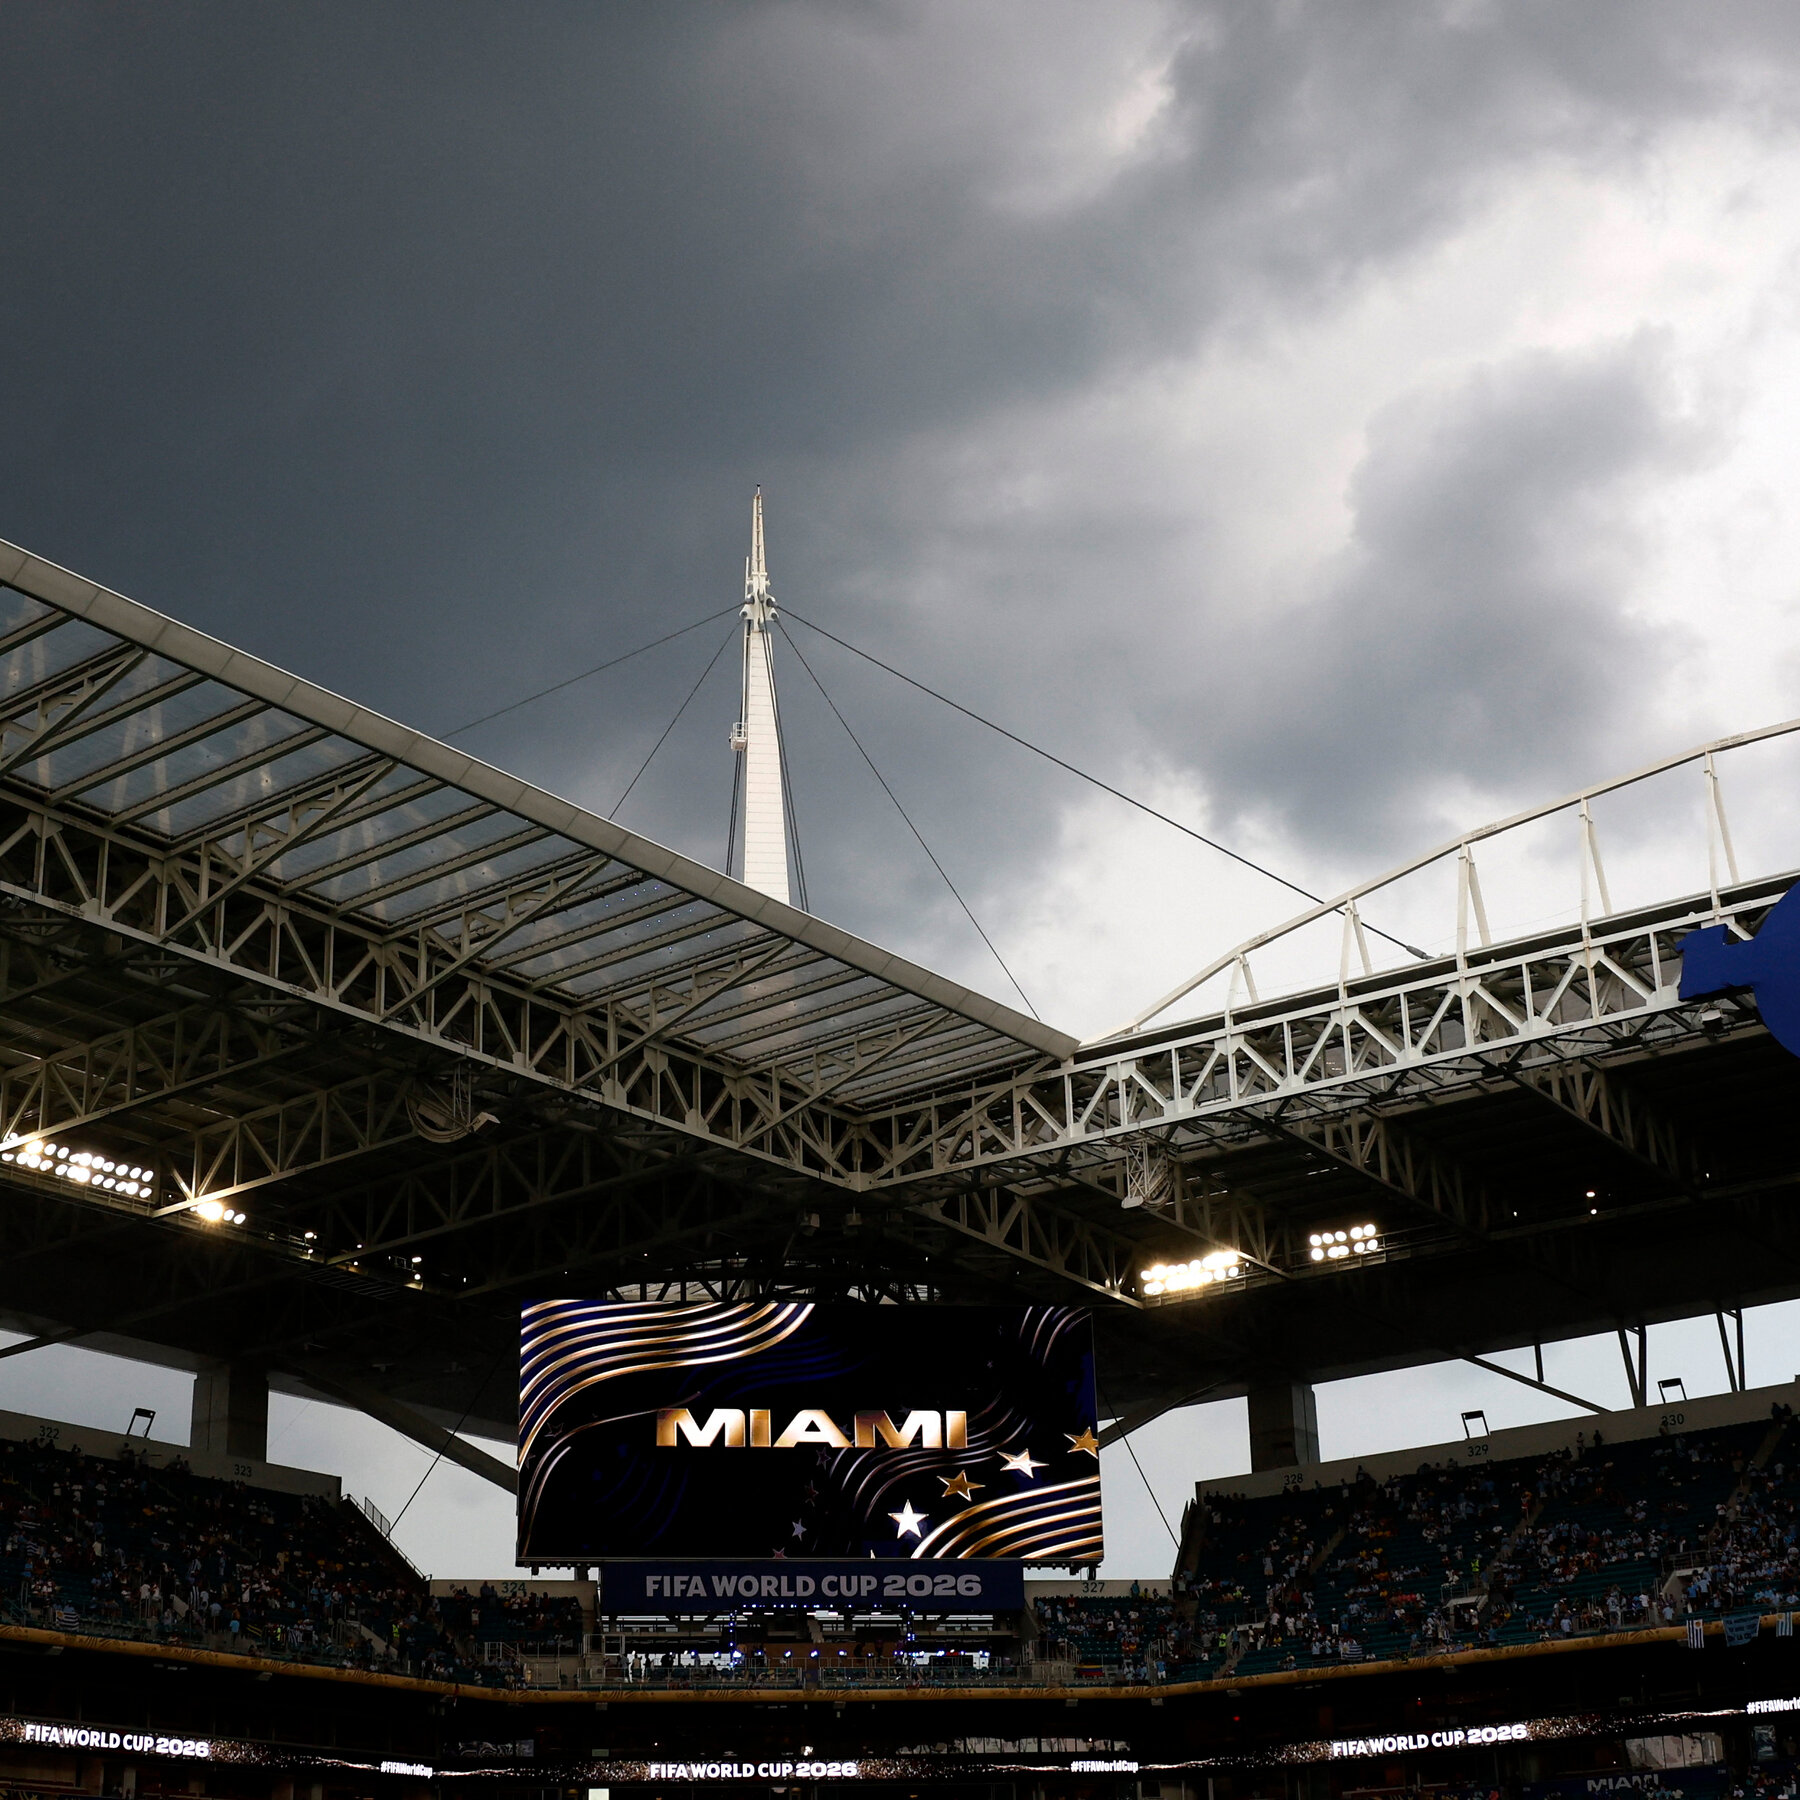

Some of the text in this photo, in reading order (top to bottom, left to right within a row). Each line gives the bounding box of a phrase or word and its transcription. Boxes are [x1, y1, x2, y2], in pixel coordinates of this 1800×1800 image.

[1661, 1413, 1685, 1426] 330
[39, 1425, 60, 1440] 322
[656, 1408, 968, 1449] MIAMI
[1467, 1444, 1489, 1457] 329
[234, 1464, 252, 1478] 323
[1283, 1472, 1304, 1486] 328
[501, 1581, 527, 1594] 324
[646, 1574, 982, 1598] FIFA WORLD CUP 2026
[1082, 1581, 1105, 1593] 327
[25, 1724, 210, 1758] FIFA WORLD CUP 2026
[1332, 1723, 1527, 1757] FIFA WORLD CUP 2026
[380, 1761, 433, 1779] #FIFAWorldCup
[650, 1762, 858, 1778] FIFA WORLD CUP 2026
[1070, 1760, 1139, 1774] #FIFAWorldCup
[1586, 1773, 1659, 1793] MIAMI
